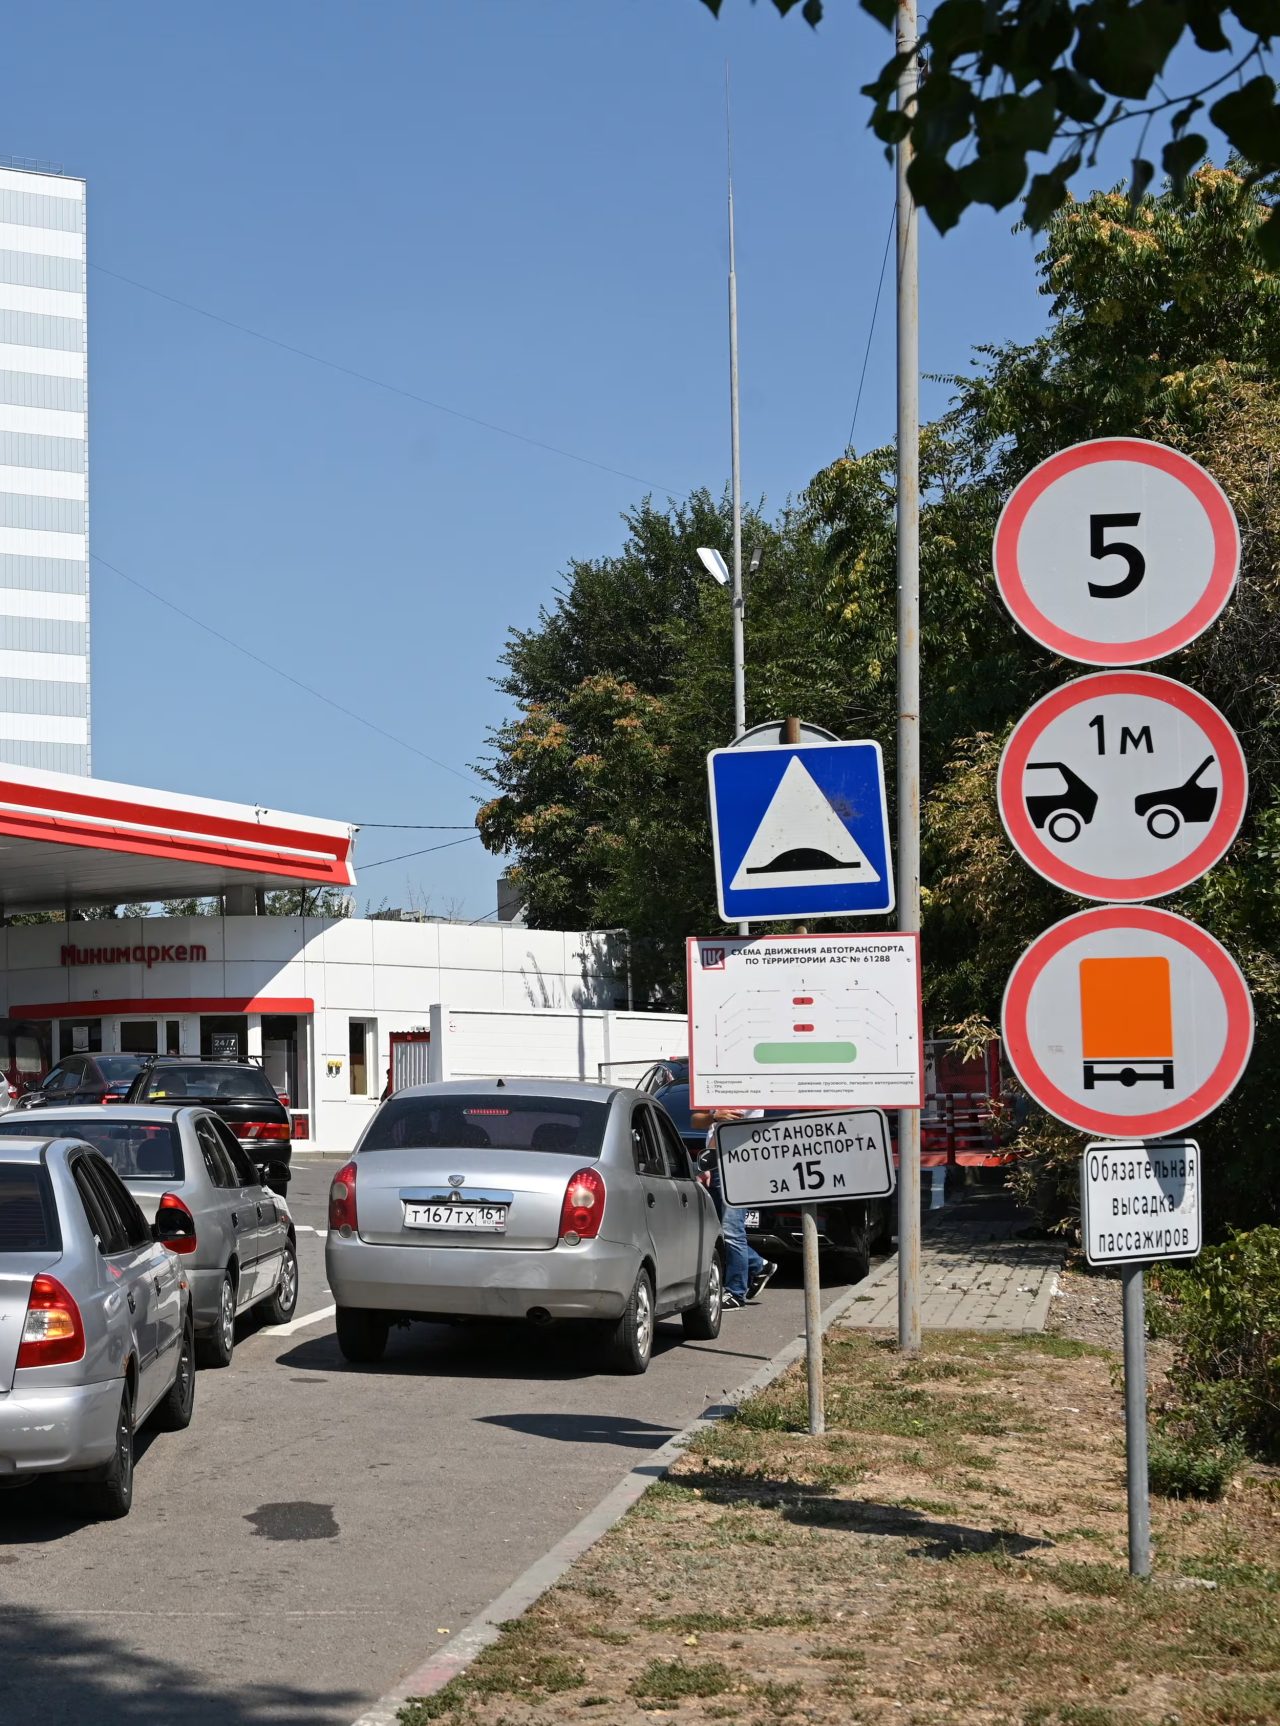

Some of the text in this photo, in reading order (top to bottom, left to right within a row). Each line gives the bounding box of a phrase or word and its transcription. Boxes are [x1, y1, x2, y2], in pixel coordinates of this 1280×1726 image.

[1087, 512, 1146, 599] 5
[1088, 714, 1106, 755] 1
[60, 943, 207, 969] Минимаркет
[731, 945, 905, 956] СХЕМА ДВИЖЕНИЯ АВТОТРАНСПОРТА
[745, 957, 759, 965] ПО
[863, 955, 891, 963] 61288
[751, 1121, 847, 1144] ОСТАНОВКА
[728, 1136, 876, 1163] МОТОТРАНСПОРТА
[769, 1179, 790, 1194] ЗА
[792, 1160, 825, 1190] 15
[1090, 1155, 1195, 1182] Обязательная
[412, 1207, 503, 1224] Т167ТХ 161
[1112, 1194, 1175, 1218] высадка
[1098, 1228, 1189, 1253] пассажиров
